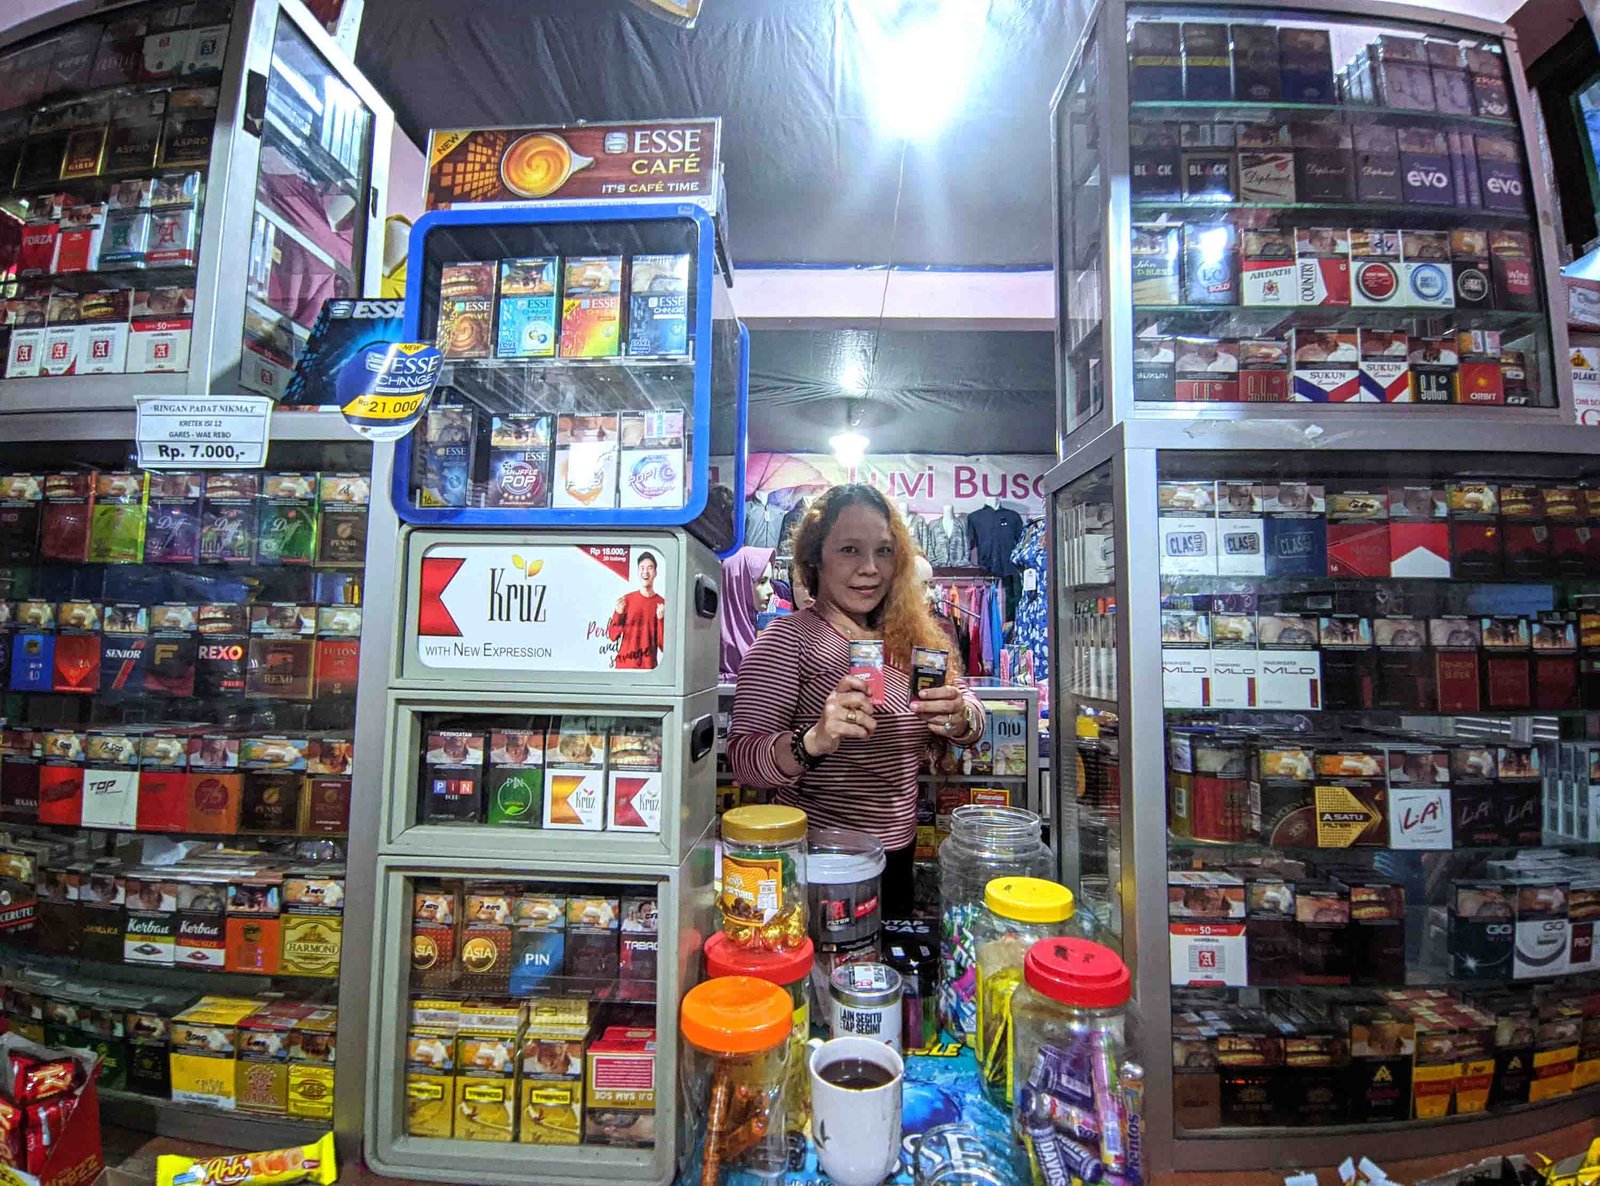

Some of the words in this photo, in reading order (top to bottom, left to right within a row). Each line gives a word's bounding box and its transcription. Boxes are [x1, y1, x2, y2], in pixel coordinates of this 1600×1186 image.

[437, 133, 460, 154] NEW
[633, 130, 701, 153] ESSE
[631, 154, 701, 175] CAFÉ
[1407, 171, 1448, 188] evo
[602, 183, 626, 194] IT'S
[629, 181, 664, 193] CAFÉ
[666, 182, 699, 192] TIME
[1487, 177, 1523, 196] evo
[23, 234, 53, 245] FORZA
[1250, 269, 1291, 280] ARDATH
[1301, 263, 1316, 302] COUNTRY
[465, 301, 491, 312] ESSE
[527, 300, 551, 309] ESSE
[588, 299, 617, 308] ESSE
[658, 297, 685, 307] ESSE
[157, 322, 167, 330] 50
[401, 343, 423, 351] NEW
[392, 354, 440, 375] ESSE
[1366, 363, 1402, 372] SUKUN
[377, 373, 433, 386] CHANGE
[1309, 371, 1346, 380] SUKUN
[1470, 392, 1497, 400] ORBIT
[153, 404, 187, 413] RINGAN
[189, 403, 218, 413] PADAT
[218, 404, 256, 413] NIKMAT
[178, 420, 203, 428] KRETEK
[204, 420, 213, 428] ISI
[214, 420, 222, 428] 12
[169, 431, 190, 439] GARES
[196, 431, 211, 439] WAE
[212, 431, 231, 439] REBO
[158, 444, 185, 459] Rp.
[190, 444, 246, 460] 7.000,-
[445, 447, 466, 456] ESSE
[525, 451, 547, 461] ESSE
[505, 468, 538, 477] SHUFFLE
[501, 475, 537, 488] POP
[1170, 536, 1194, 554] CLAS
[1227, 535, 1248, 552] CLAS
[1280, 537, 1303, 555] CLAS
[590, 548, 601, 557] Rp
[601, 547, 628, 557] 18.000,-
[487, 567, 547, 622] Kruz
[106, 648, 142, 659] SENIOR
[198, 645, 243, 660] REXO
[425, 645, 451, 656] WITH
[598, 640, 621, 656] and
[1162, 666, 1207, 674] MLD
[1263, 666, 1316, 675] MLD
[264, 674, 293, 684] REXO
[89, 780, 117, 792] TOP
[437, 781, 473, 793] PIN
[506, 776, 525, 788] PIN
[575, 791, 596, 809] Kruz
[639, 794, 660, 811] Kruz
[127, 918, 170, 935] Kerbau
[180, 920, 219, 935] Kerbau
[1199, 925, 1212, 934] 50
[462, 944, 493, 962] ASIA
[525, 953, 550, 966] PIN
[856, 1012, 882, 1025] SEGITU
[856, 1022, 881, 1035] SEGINI
